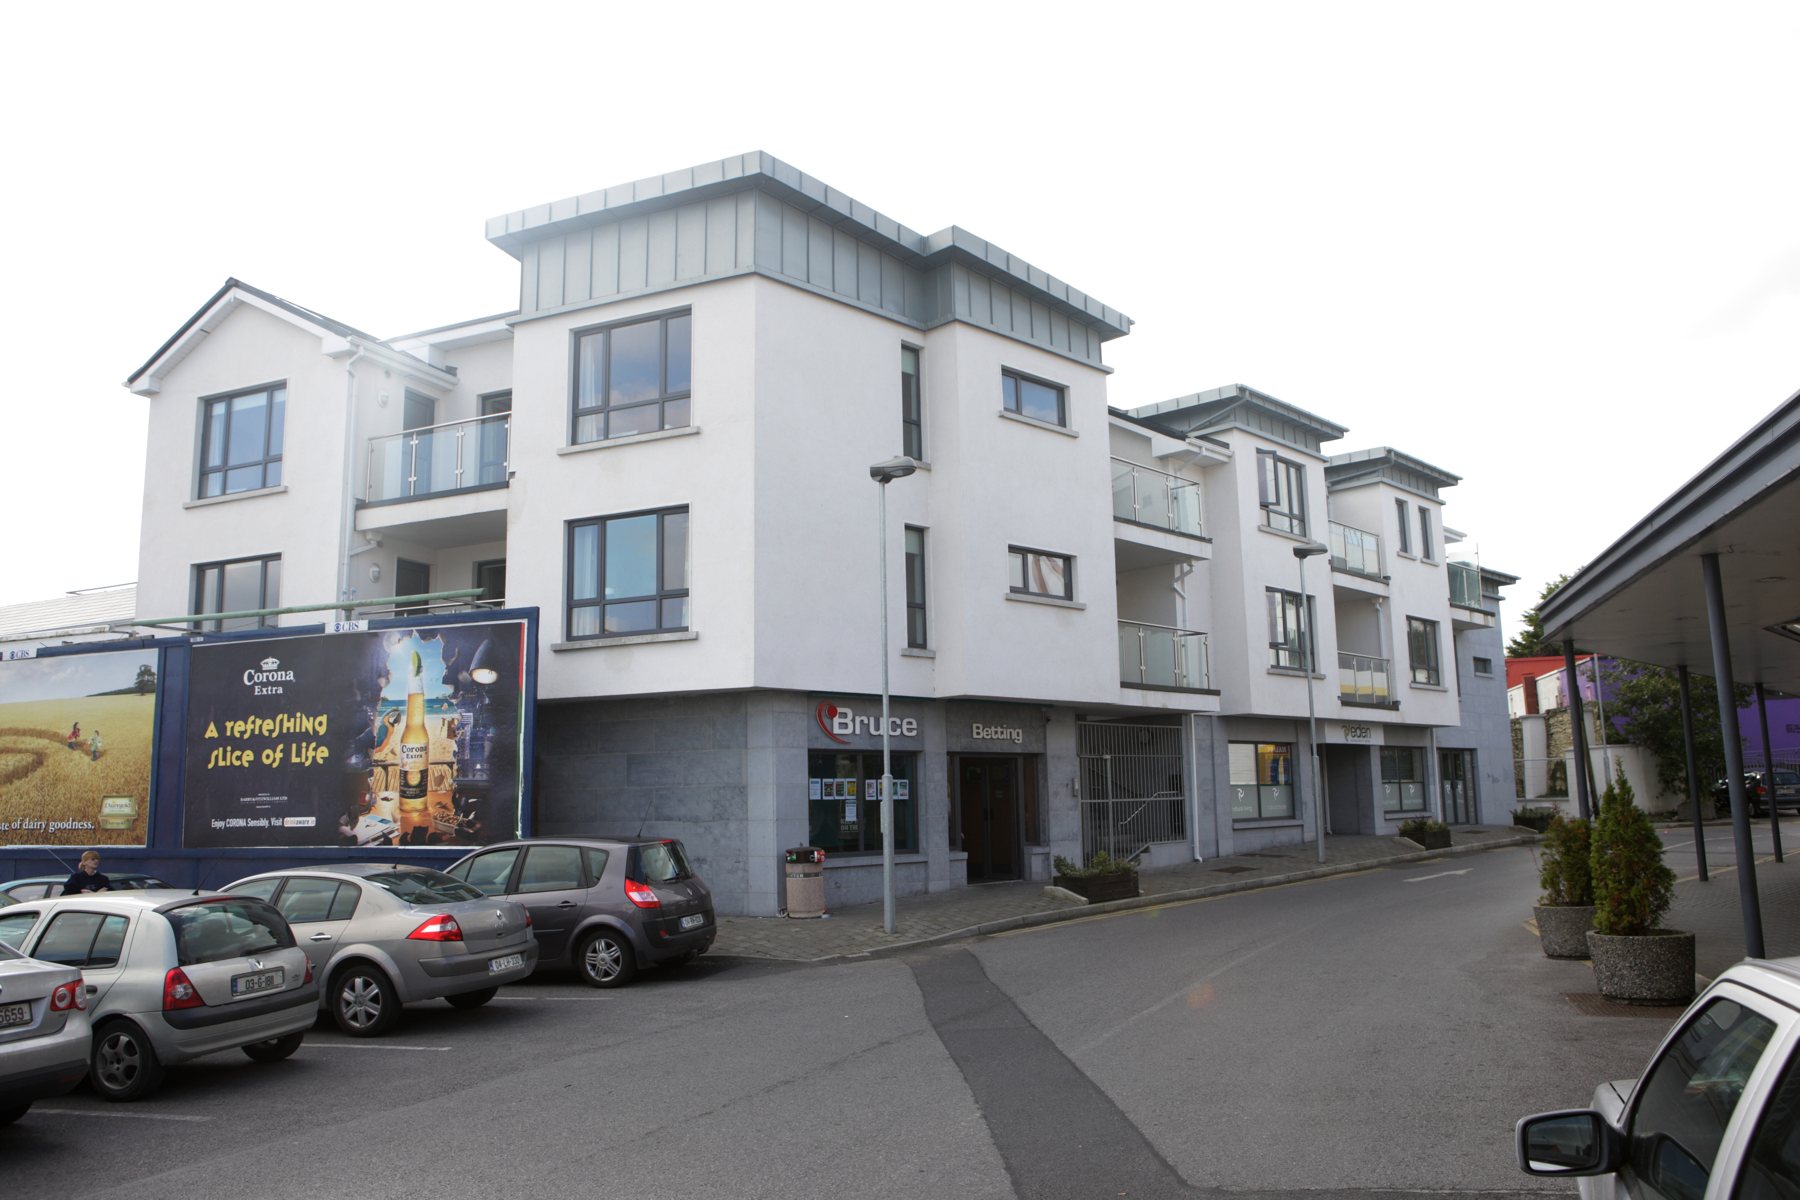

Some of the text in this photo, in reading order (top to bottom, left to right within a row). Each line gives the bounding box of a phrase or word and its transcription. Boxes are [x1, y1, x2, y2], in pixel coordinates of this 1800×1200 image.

[243, 669, 294, 686] Corona
[254, 685, 283, 695] Extra
[204, 721, 219, 739] A
[833, 707, 918, 737] Bruce
[972, 723, 1023, 743] Betting
[261, 743, 284, 769] of
[401, 744, 427, 753] Corona
[11, 818, 21, 830] of
[23, 817, 45, 832] dairy
[48, 817, 95, 832] goodness.
[211, 819, 225, 830] Enjoy
[226, 818, 246, 828] CORONA
[247, 818, 269, 829] Sensibly.
[270, 817, 283, 826] Visit
